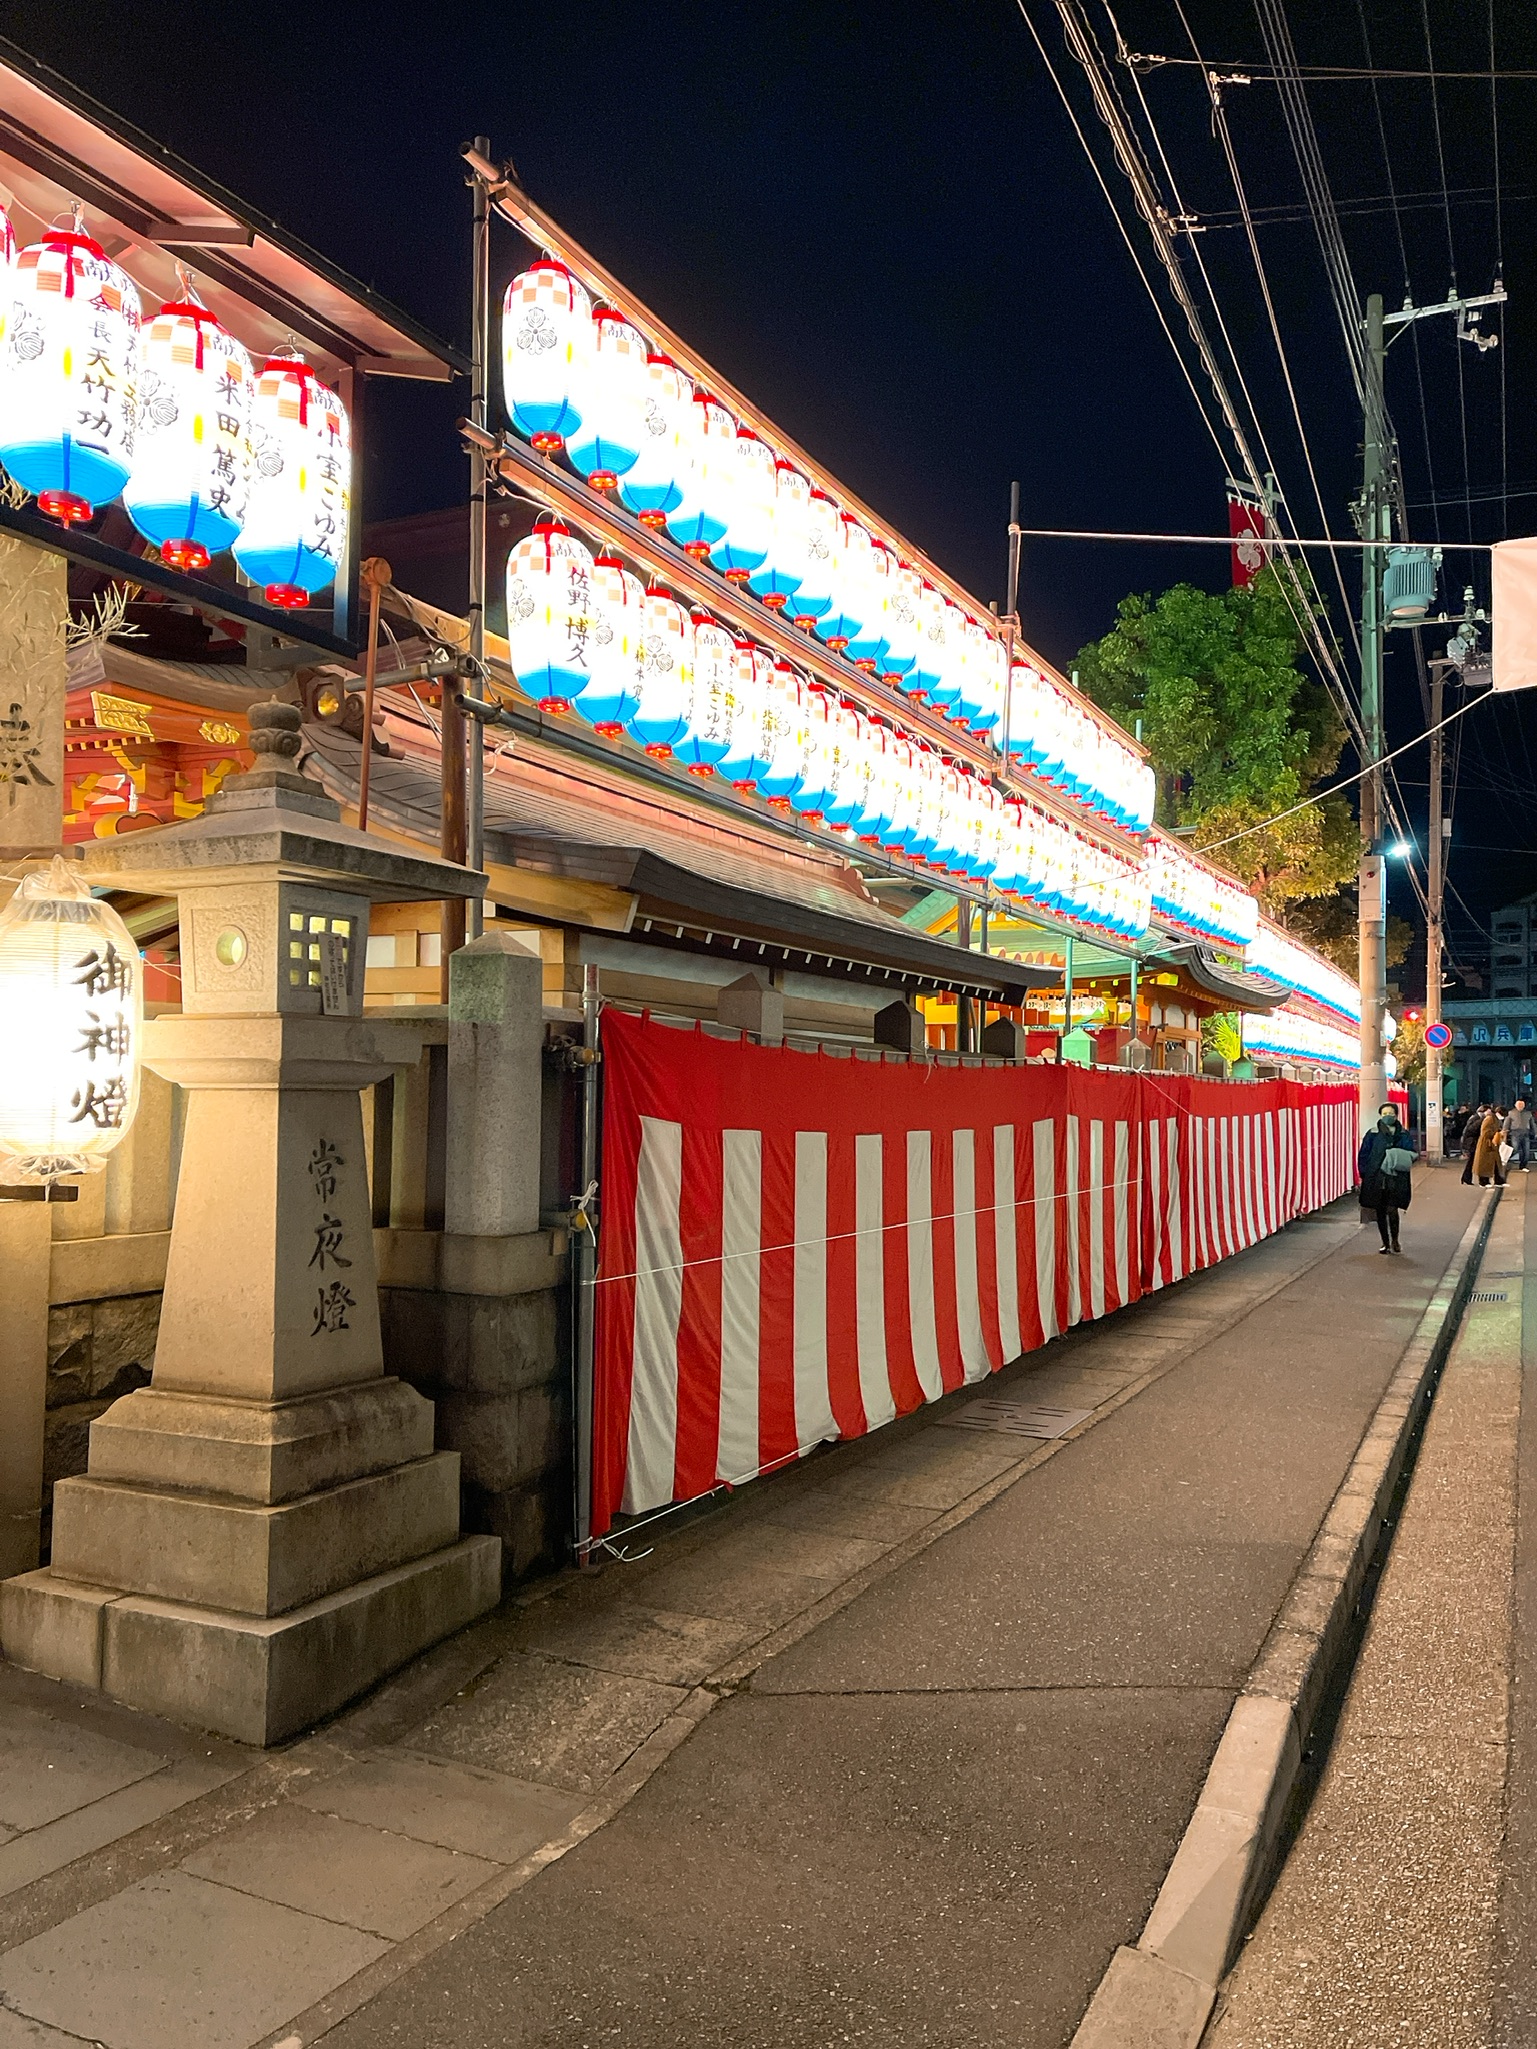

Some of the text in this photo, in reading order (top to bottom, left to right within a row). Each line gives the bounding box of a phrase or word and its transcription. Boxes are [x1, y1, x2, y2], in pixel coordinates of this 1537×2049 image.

[206, 371, 242, 520] 米田篤史
[303, 422, 343, 559] 小室こゆみ
[565, 566, 590, 667] 佐野博久
[704, 663, 723, 739] 小室こゆみ
[68, 940, 133, 1129] 御神燈
[308, 1138, 356, 1337] 常夜燈
